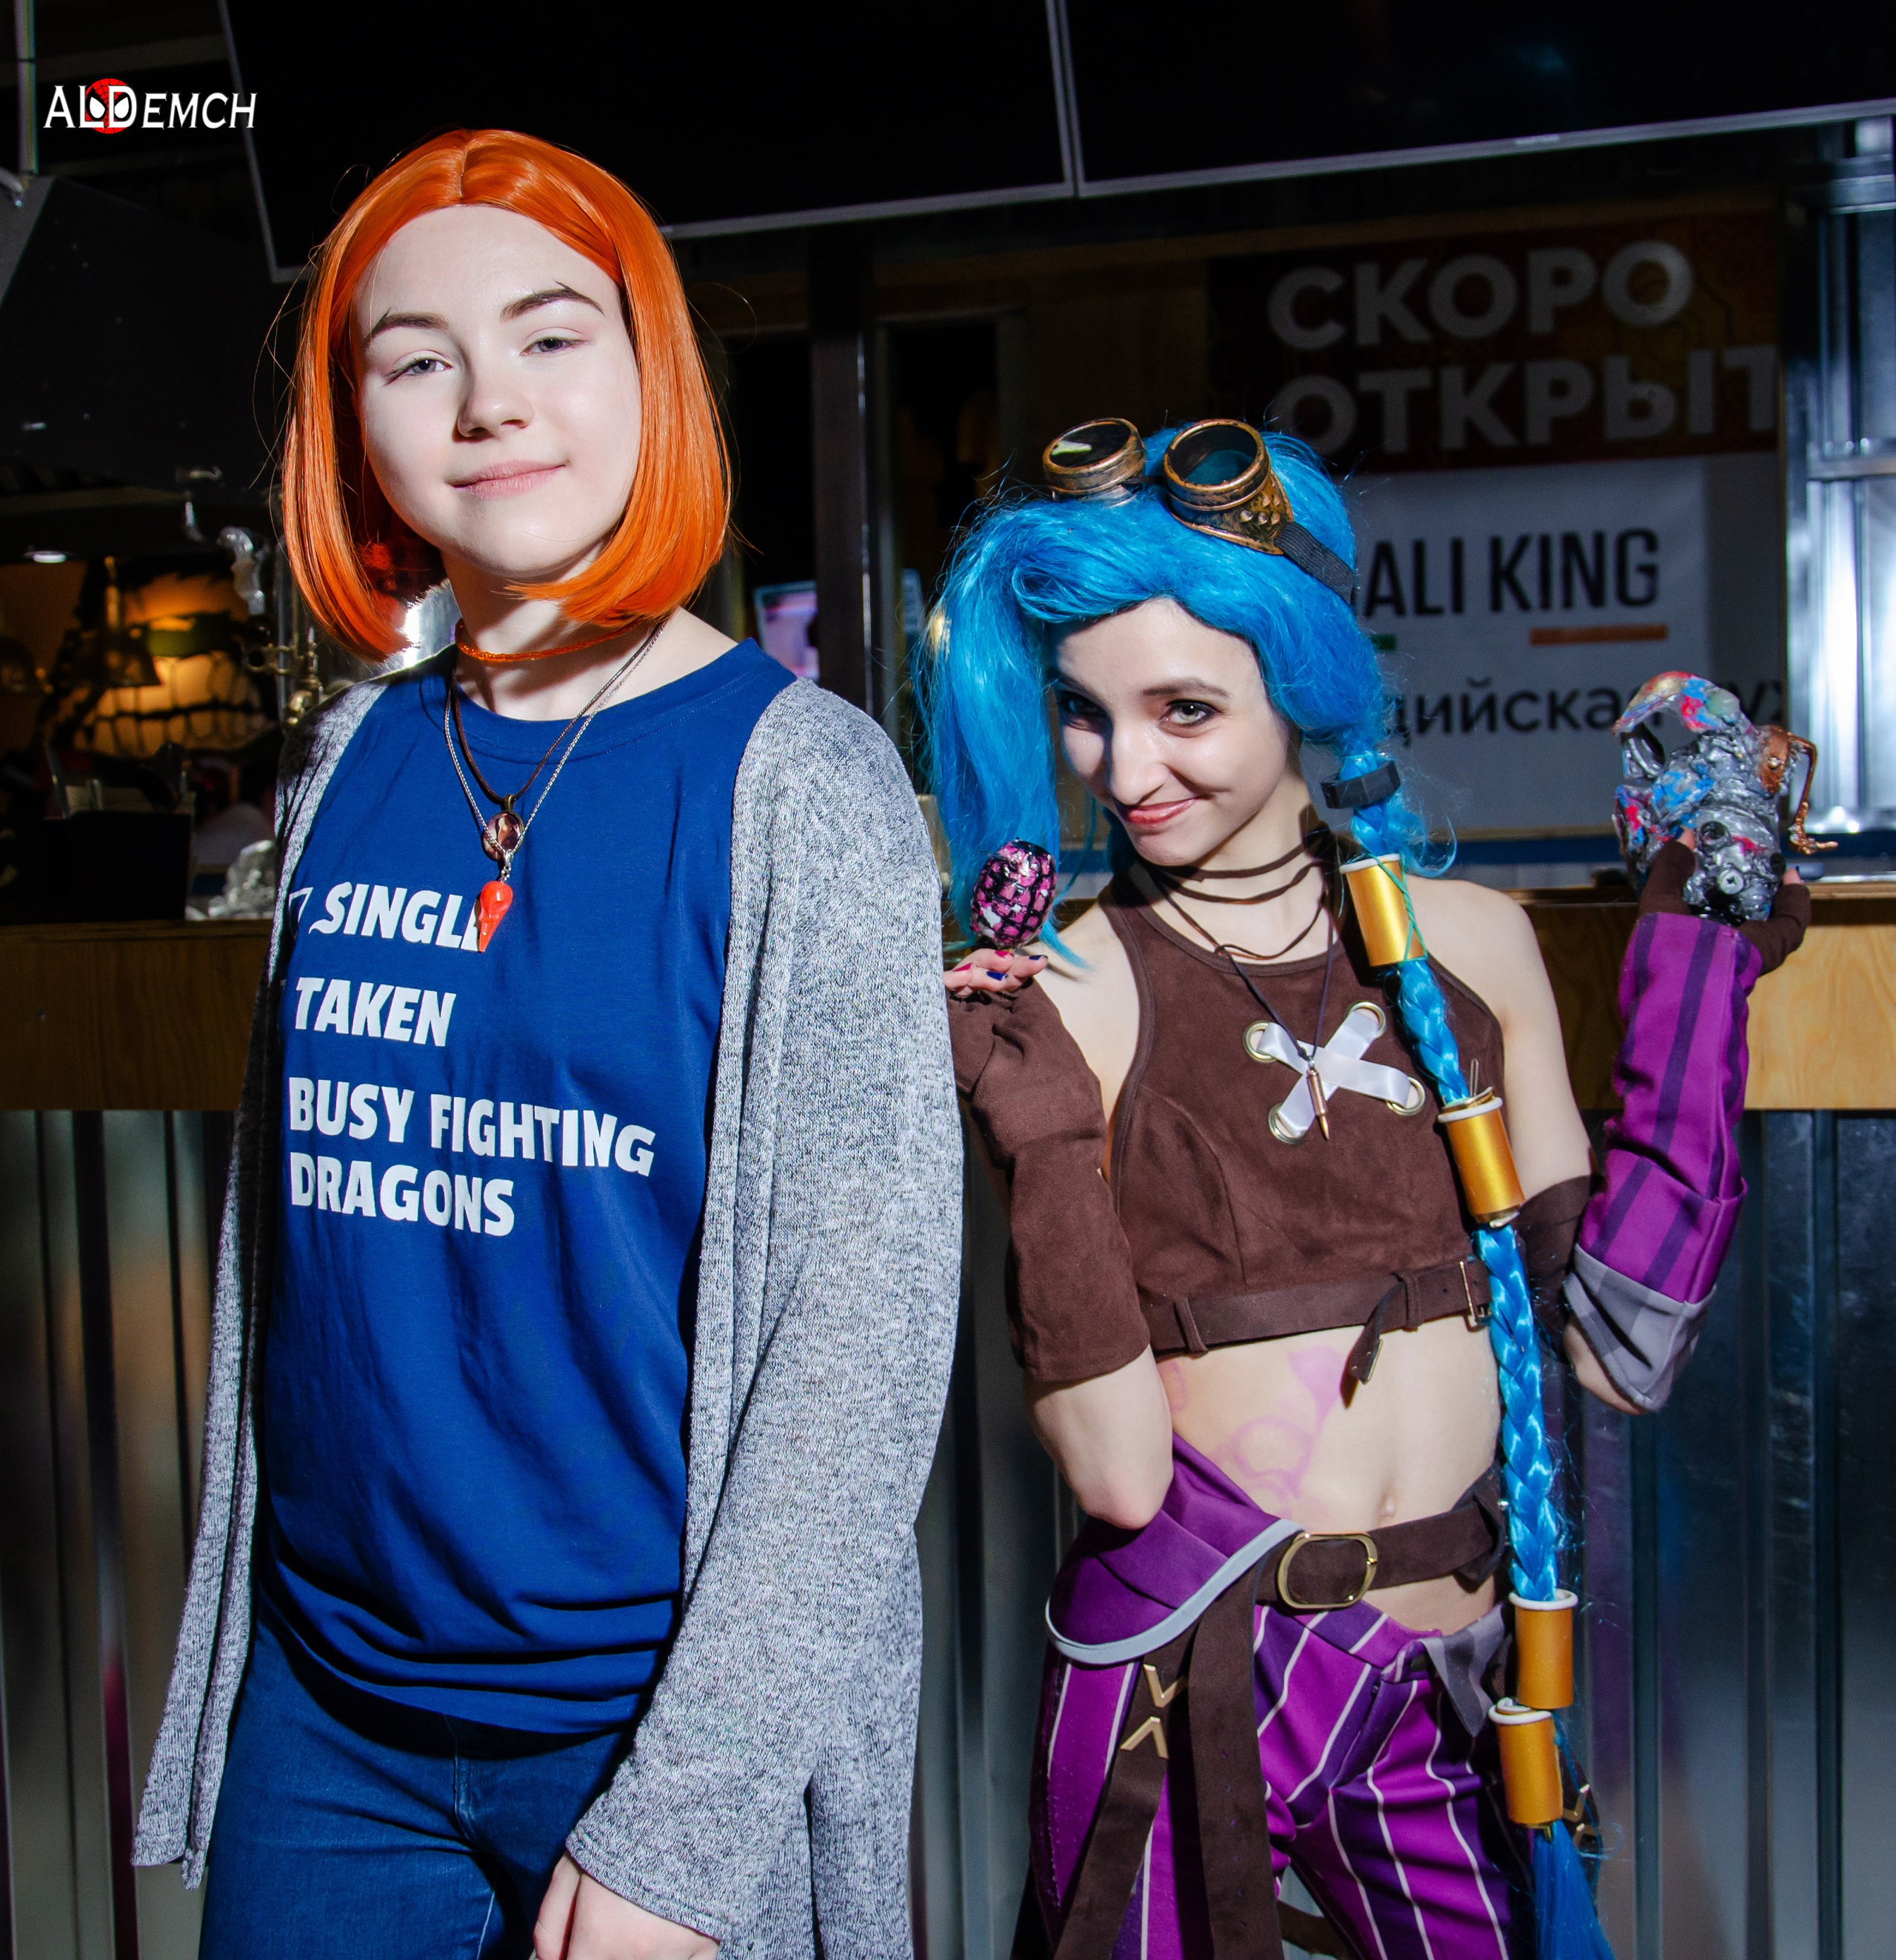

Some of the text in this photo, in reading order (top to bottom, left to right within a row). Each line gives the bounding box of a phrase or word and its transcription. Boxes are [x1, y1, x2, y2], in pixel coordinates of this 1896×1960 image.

[1267, 241, 1693, 350] СКОРО
[1267, 345, 1778, 458] ОТКРЫТ
[1351, 529, 1659, 618] ALI KING
[296, 977, 456, 1047] TAKEN
[289, 1077, 656, 1176] BUSY FIGHTING
[290, 1152, 514, 1236] DRAGONS
